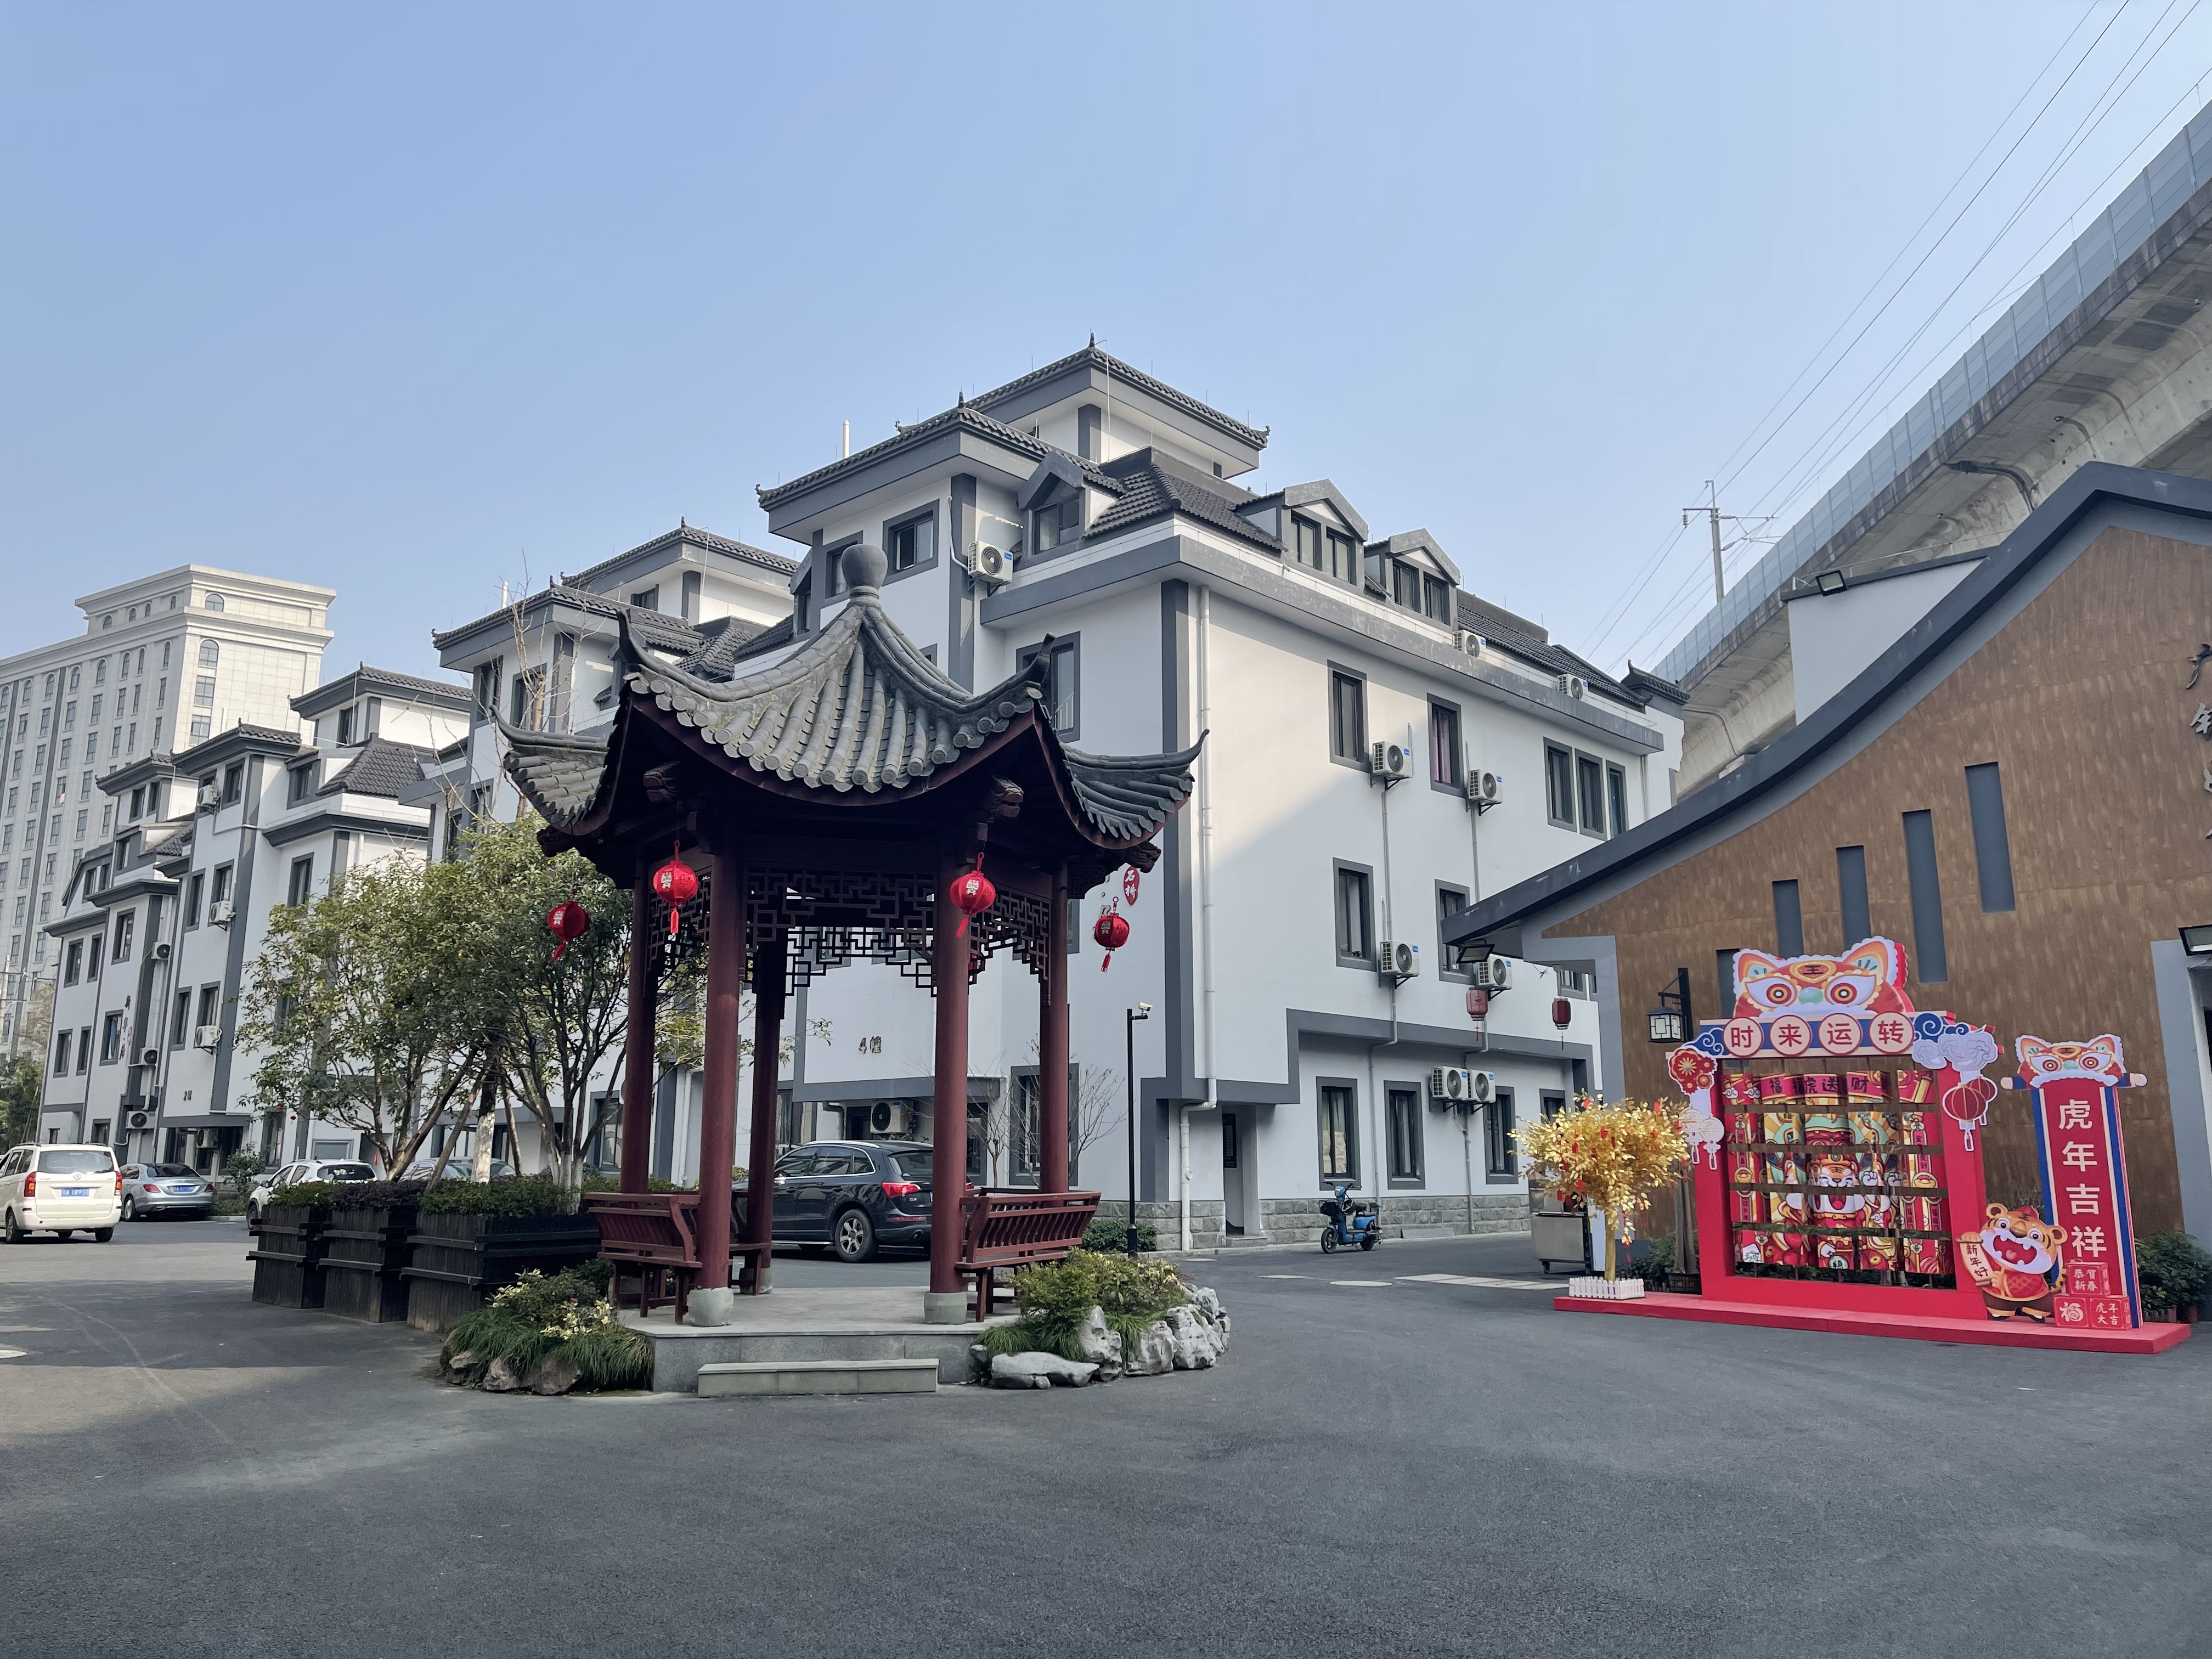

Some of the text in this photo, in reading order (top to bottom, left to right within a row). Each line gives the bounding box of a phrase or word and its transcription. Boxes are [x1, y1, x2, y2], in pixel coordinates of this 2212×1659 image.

[1731, 1020, 1903, 1047] 时来运转
[859, 1036, 882, 1053] 4幢
[2059, 1099, 2107, 1257] 虎年吉祥
[1966, 1243, 1989, 1278] 新年好
[2075, 1281, 2098, 1291] 新春
[2059, 1302, 2084, 1322] 福
[2096, 1302, 2118, 1314] 虎年
[2097, 1314, 2119, 1325] 大吉
